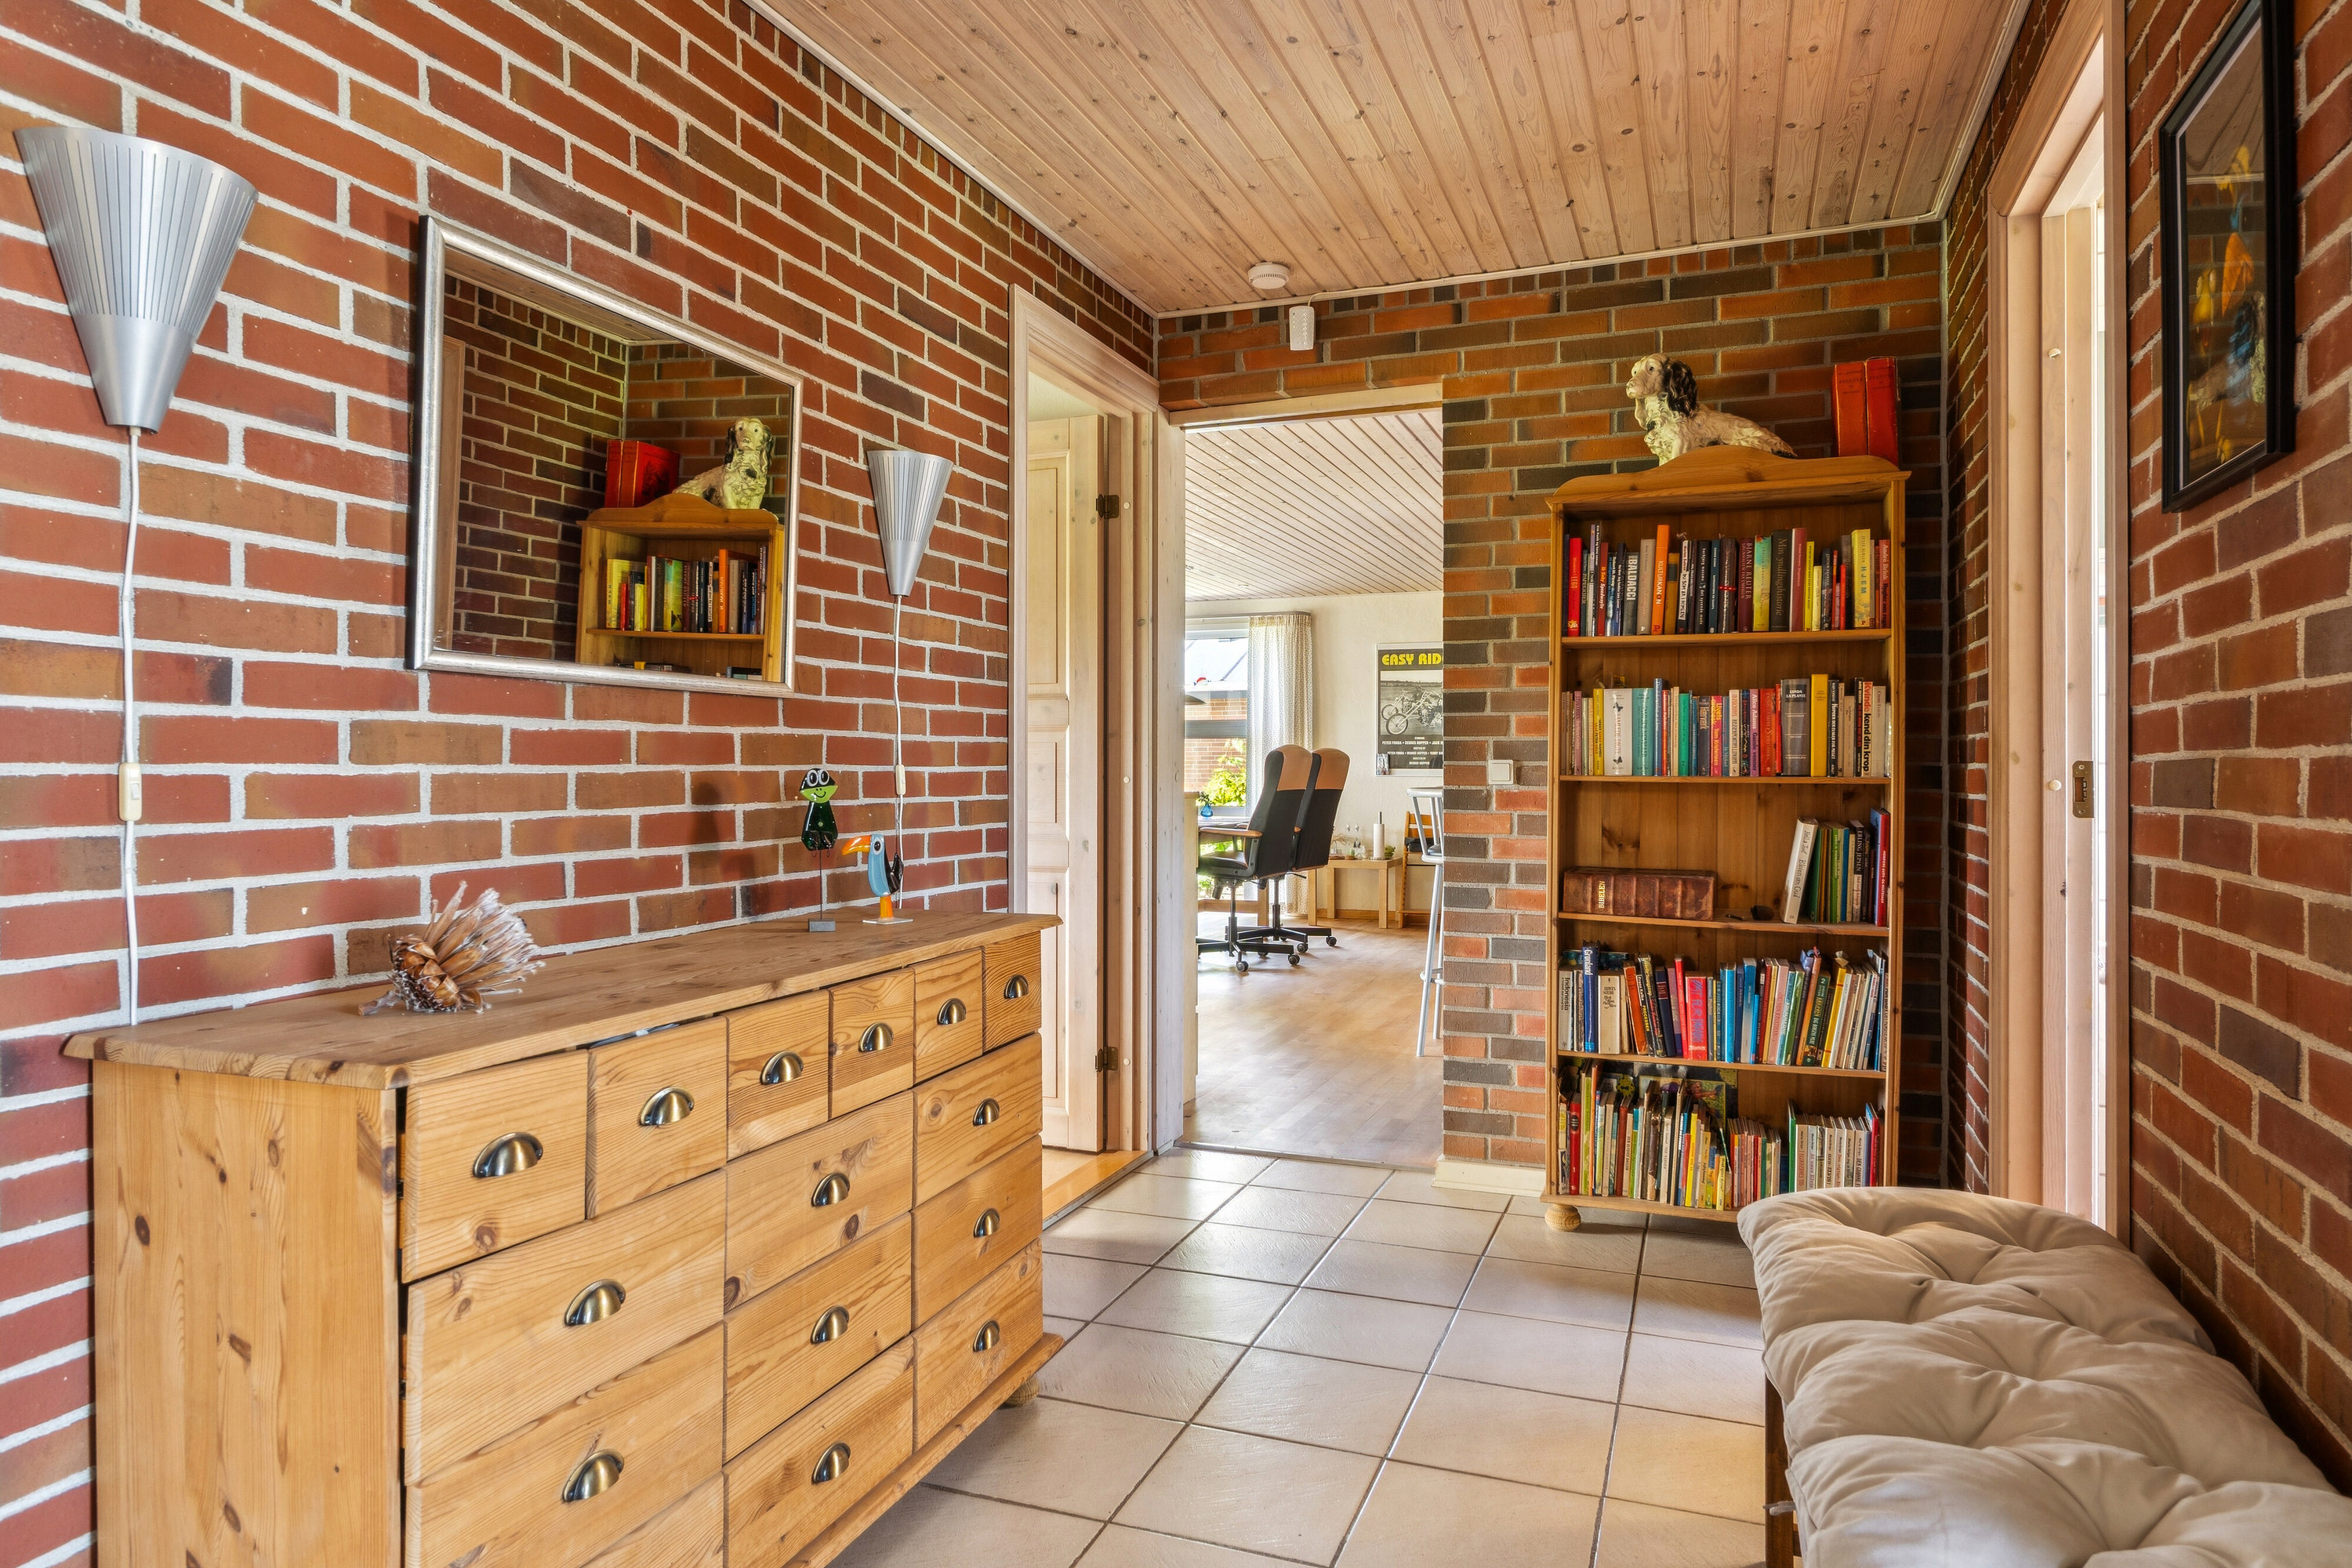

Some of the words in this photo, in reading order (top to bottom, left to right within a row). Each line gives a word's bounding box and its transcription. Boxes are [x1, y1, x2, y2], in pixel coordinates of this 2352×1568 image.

[1777, 538, 1788, 554] Min
[1626, 560, 1638, 601] BALDACCI
[1775, 557, 1787, 616] yndlingshistorie
[1882, 603, 1887, 613] om
[1381, 654, 1414, 666] EASY
[1418, 653, 1443, 665] RID
[1699, 706, 1710, 730] Hærværk
[1584, 949, 1593, 975] Grønland
